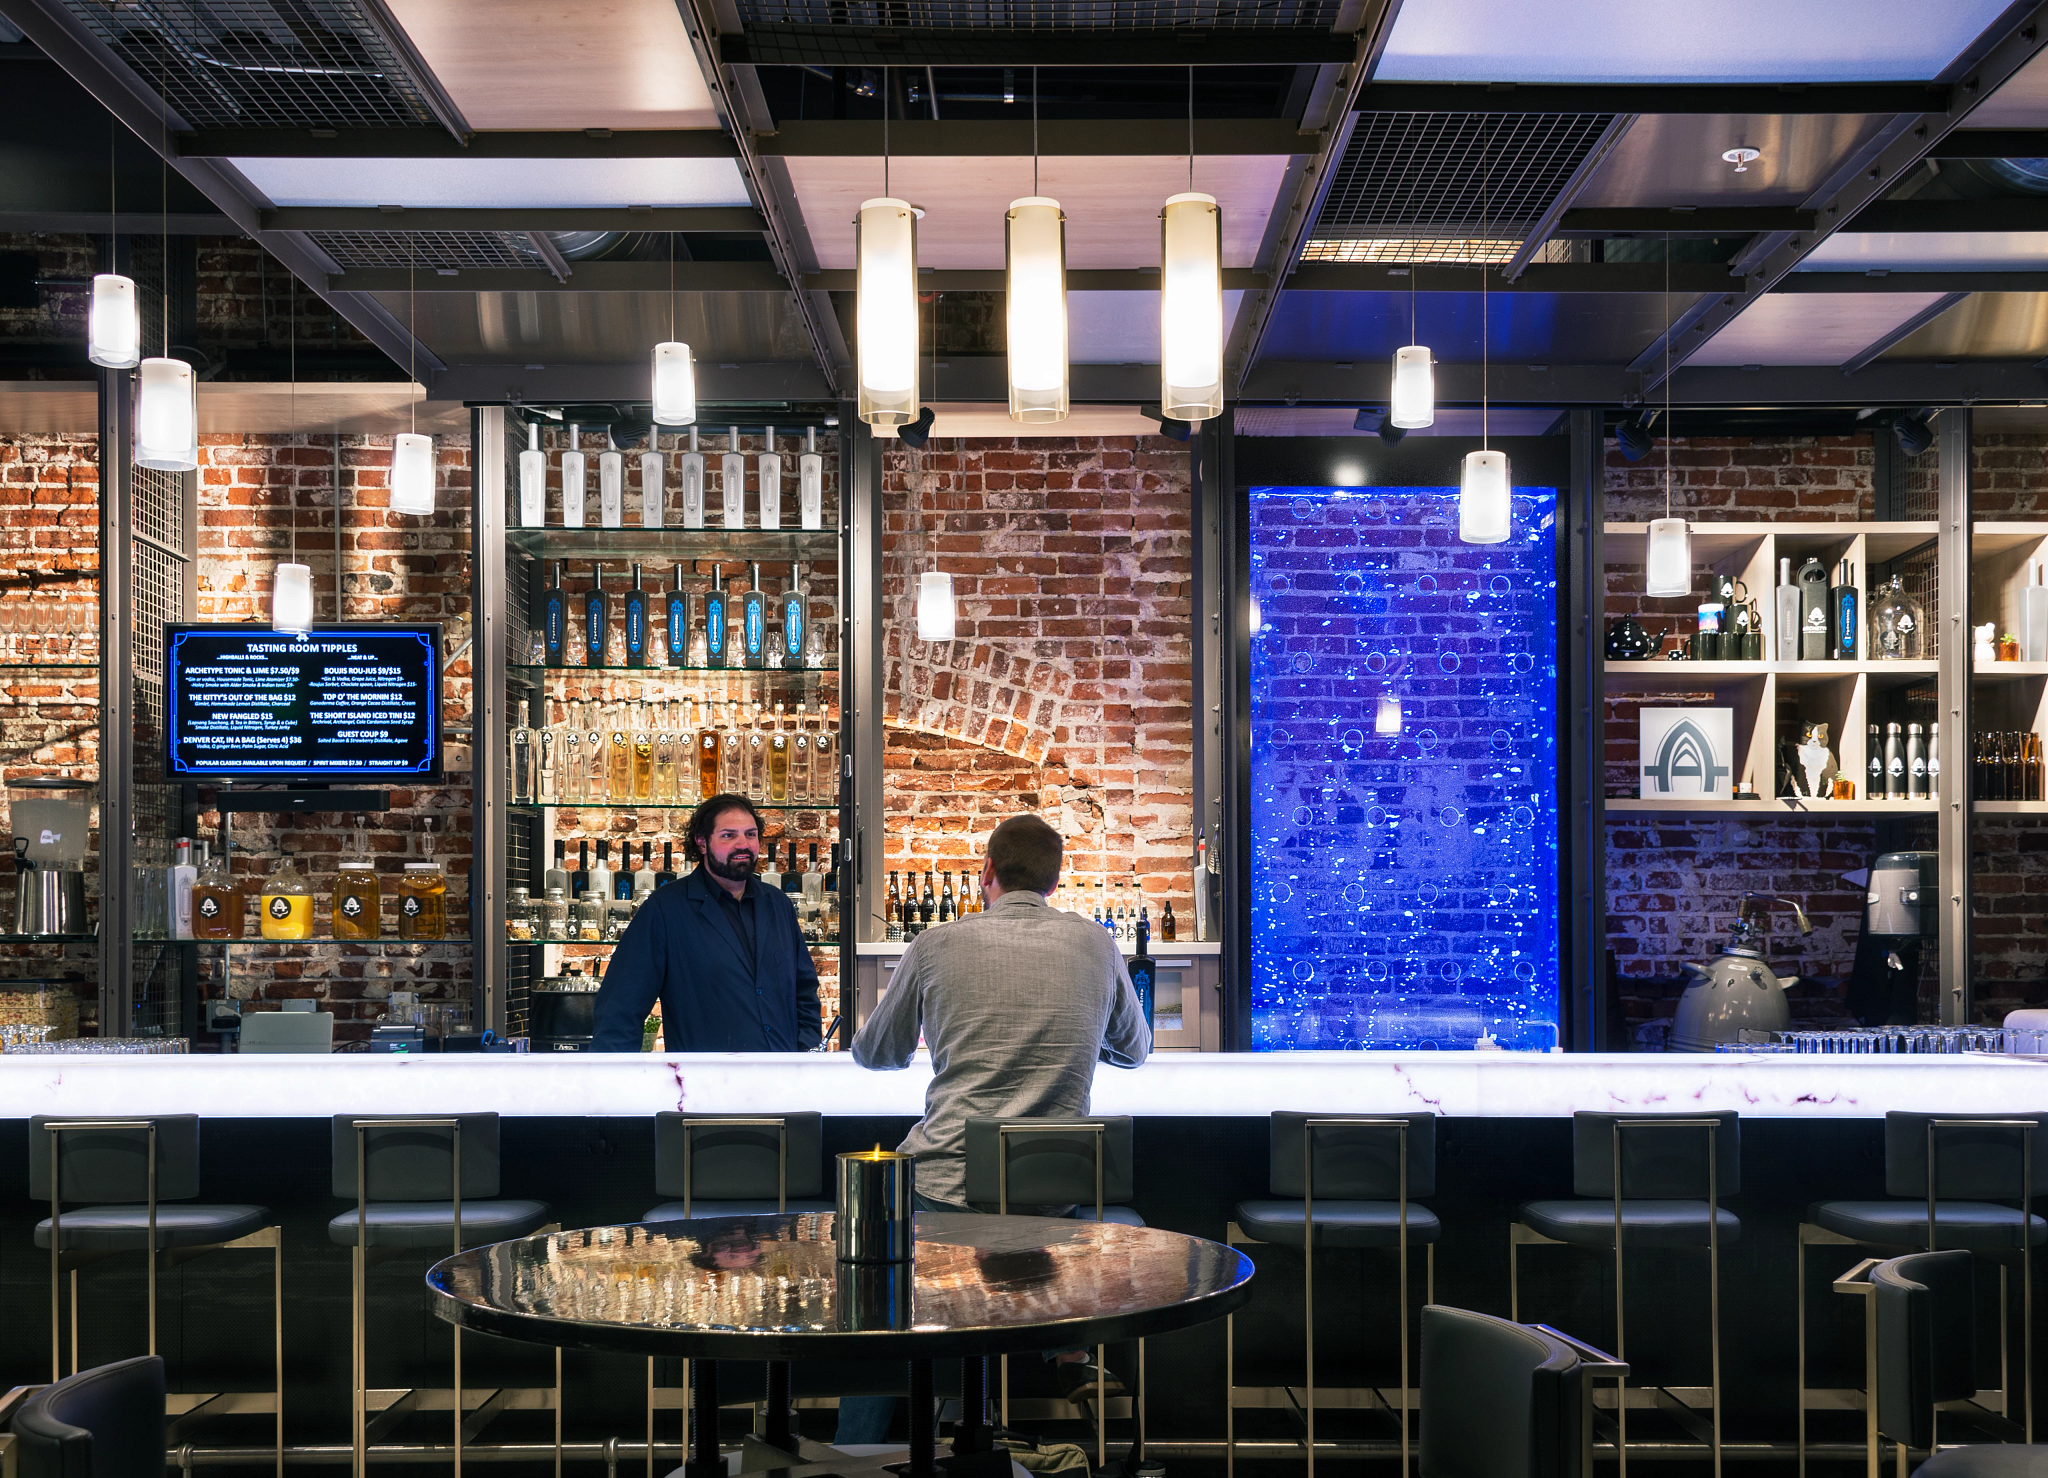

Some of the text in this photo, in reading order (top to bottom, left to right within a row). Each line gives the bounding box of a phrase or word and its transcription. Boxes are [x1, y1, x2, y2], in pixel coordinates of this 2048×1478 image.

[246, 643, 358, 653] TASTING ROOM TIPPLES
[223, 667, 245, 675] TONIC
[270, 666, 300, 675] $7.50/$9
[324, 666, 402, 676] BOUJIS ROU-JUS $9/$15
[188, 693, 203, 701] THE
[202, 693, 228, 701] KITTY'S
[227, 693, 244, 701] OUT
[243, 693, 254, 701] OF
[268, 693, 283, 701] BAG
[283, 693, 297, 702] $12
[322, 693, 336, 701] TOP
[337, 693, 346, 701] O'
[346, 693, 360, 701] THE
[390, 692, 403, 702] $12
[212, 712, 274, 721] NEW FANGLED $15
[403, 711, 416, 720] $12
[337, 730, 389, 739] GUEST COUP $9
[183, 735, 302, 745] DENVER CAT, IN A BAG (Serves 4) $36
